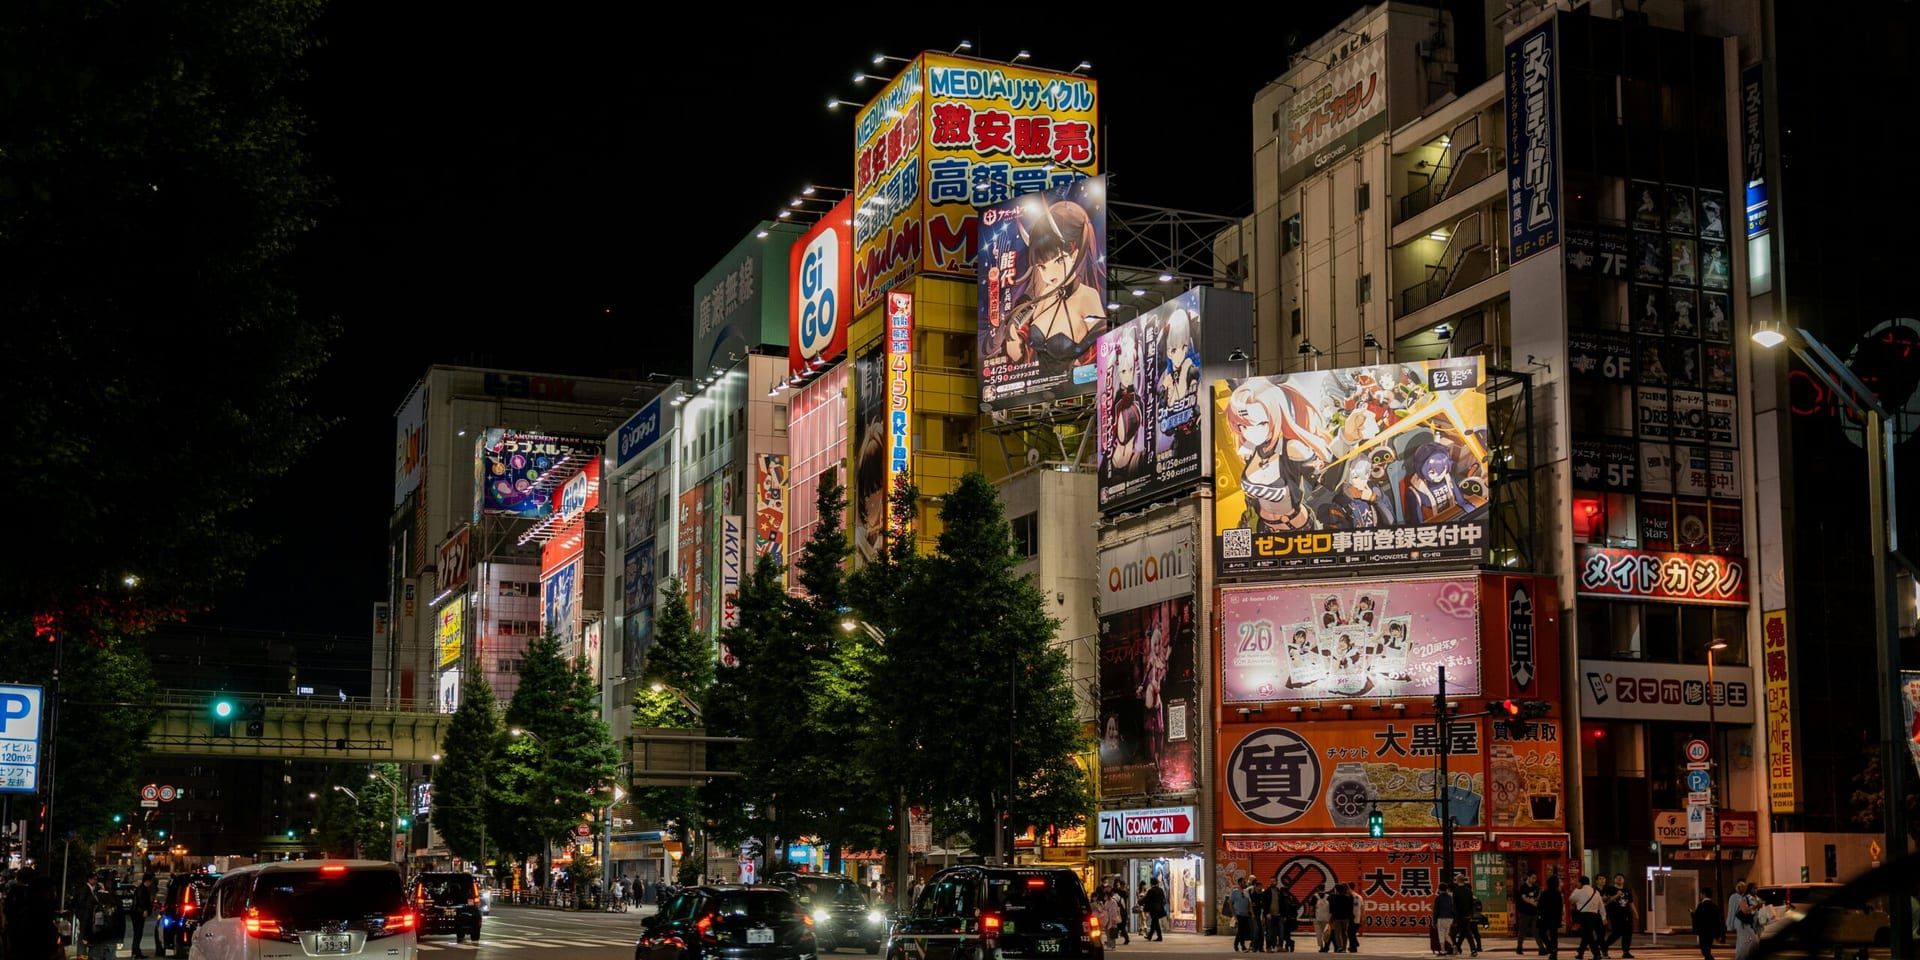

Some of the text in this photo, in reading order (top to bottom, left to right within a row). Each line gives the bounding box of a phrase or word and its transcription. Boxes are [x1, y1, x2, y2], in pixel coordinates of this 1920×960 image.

[930, 68, 1092, 110] MEDIAリサイクル
[1287, 71, 1377, 156] メイドカジノ
[932, 103, 1090, 162] 激安販売
[857, 105, 920, 192] 激安販売
[856, 220, 922, 307] Mulan
[1600, 253, 1628, 276] 7F
[1603, 355, 1631, 379] 6F
[1608, 463, 1635, 487] 5F
[1254, 524, 1482, 557] ゼンゼロ事前登録受付中
[1108, 548, 1183, 593] amiami
[1583, 554, 1742, 595] メイドカジノ
[1238, 622, 1273, 653] 20
[1766, 616, 1787, 682] 免税
[1618, 680, 1747, 705] スマホ修理王
[1779, 686, 1788, 723] TAX
[0, 693, 31, 733] P
[1373, 723, 1480, 757] 大黒屋
[1494, 721, 1557, 742] 質買取
[1327, 747, 1369, 760] チケット
[1692, 747, 1703, 756] 40
[1781, 729, 1791, 778] FREE
[7, 778, 25, 787] 左折
[1238, 742, 1309, 812] 質
[1692, 775, 1701, 789] P
[1101, 812, 1124, 842] ZIN
[1126, 816, 1174, 835] COMIC ZIN
[1657, 826, 1687, 836] TOKIS
[1474, 853, 1505, 865] LINE
[1364, 900, 1432, 912] Daikok
